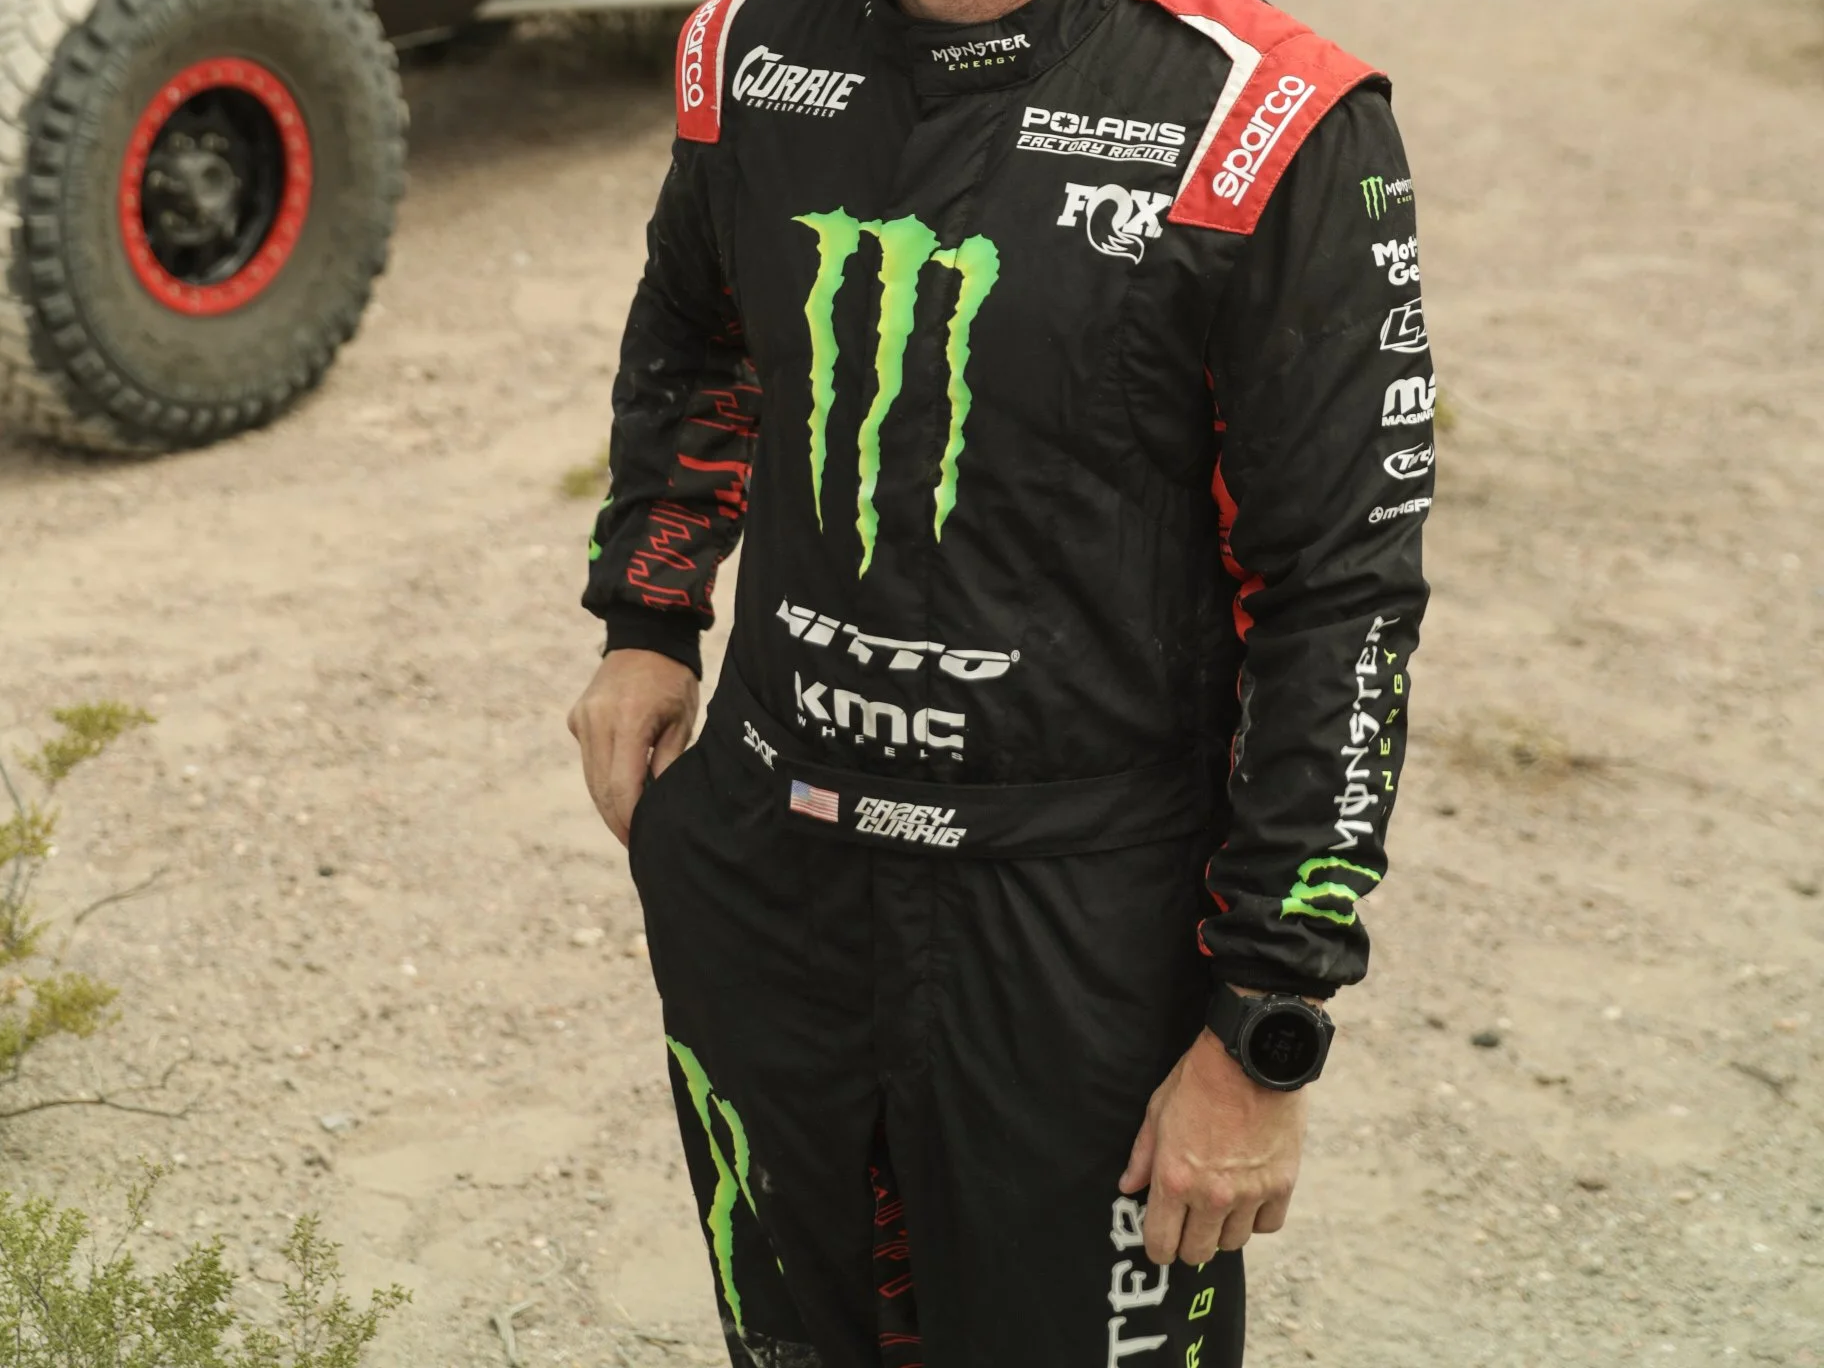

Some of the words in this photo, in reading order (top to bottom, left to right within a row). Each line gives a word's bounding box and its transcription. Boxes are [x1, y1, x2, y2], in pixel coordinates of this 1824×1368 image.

[931, 33, 1031, 63] MONSTER
[948, 54, 1017, 71] ENERGY
[732, 44, 866, 111] CURRIE
[747, 98, 836, 118] ENTERPRISES
[1022, 106, 1187, 146] POLARIS
[1017, 135, 1105, 154] FACTORY
[1107, 145, 1180, 164] RACING
[1212, 75, 1306, 199] sparco
[1056, 182, 1174, 265] FOX
[796, 713, 964, 761] WHEELS
[1377, 647, 1403, 816] NERGY
[854, 796, 956, 827] CASEY
[856, 815, 967, 848] CURRIE
